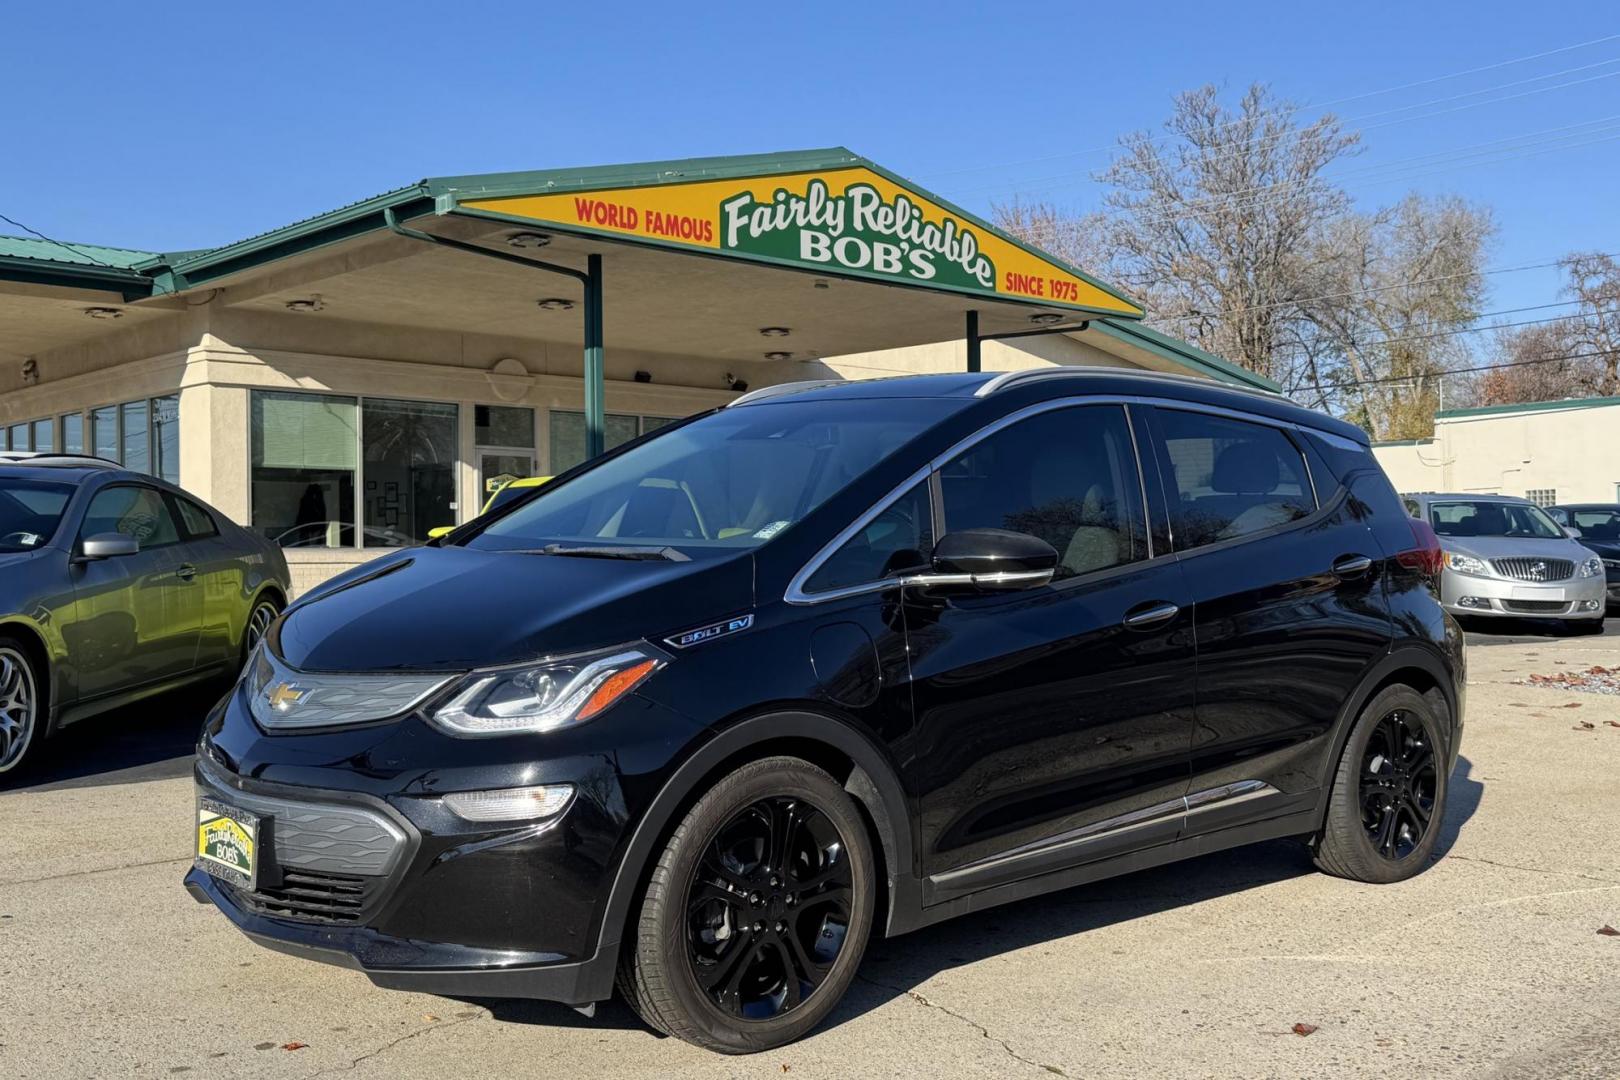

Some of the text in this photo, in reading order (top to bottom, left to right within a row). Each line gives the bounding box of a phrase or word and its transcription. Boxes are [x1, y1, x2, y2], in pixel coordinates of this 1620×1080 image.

[574, 197, 713, 242] WORLD FAMOUS
[724, 182, 994, 288] Fairly Reliable
[800, 229, 936, 279] BOB'S
[1006, 272, 1078, 301] SINCE 1975
[681, 617, 748, 644] BOLT EV
